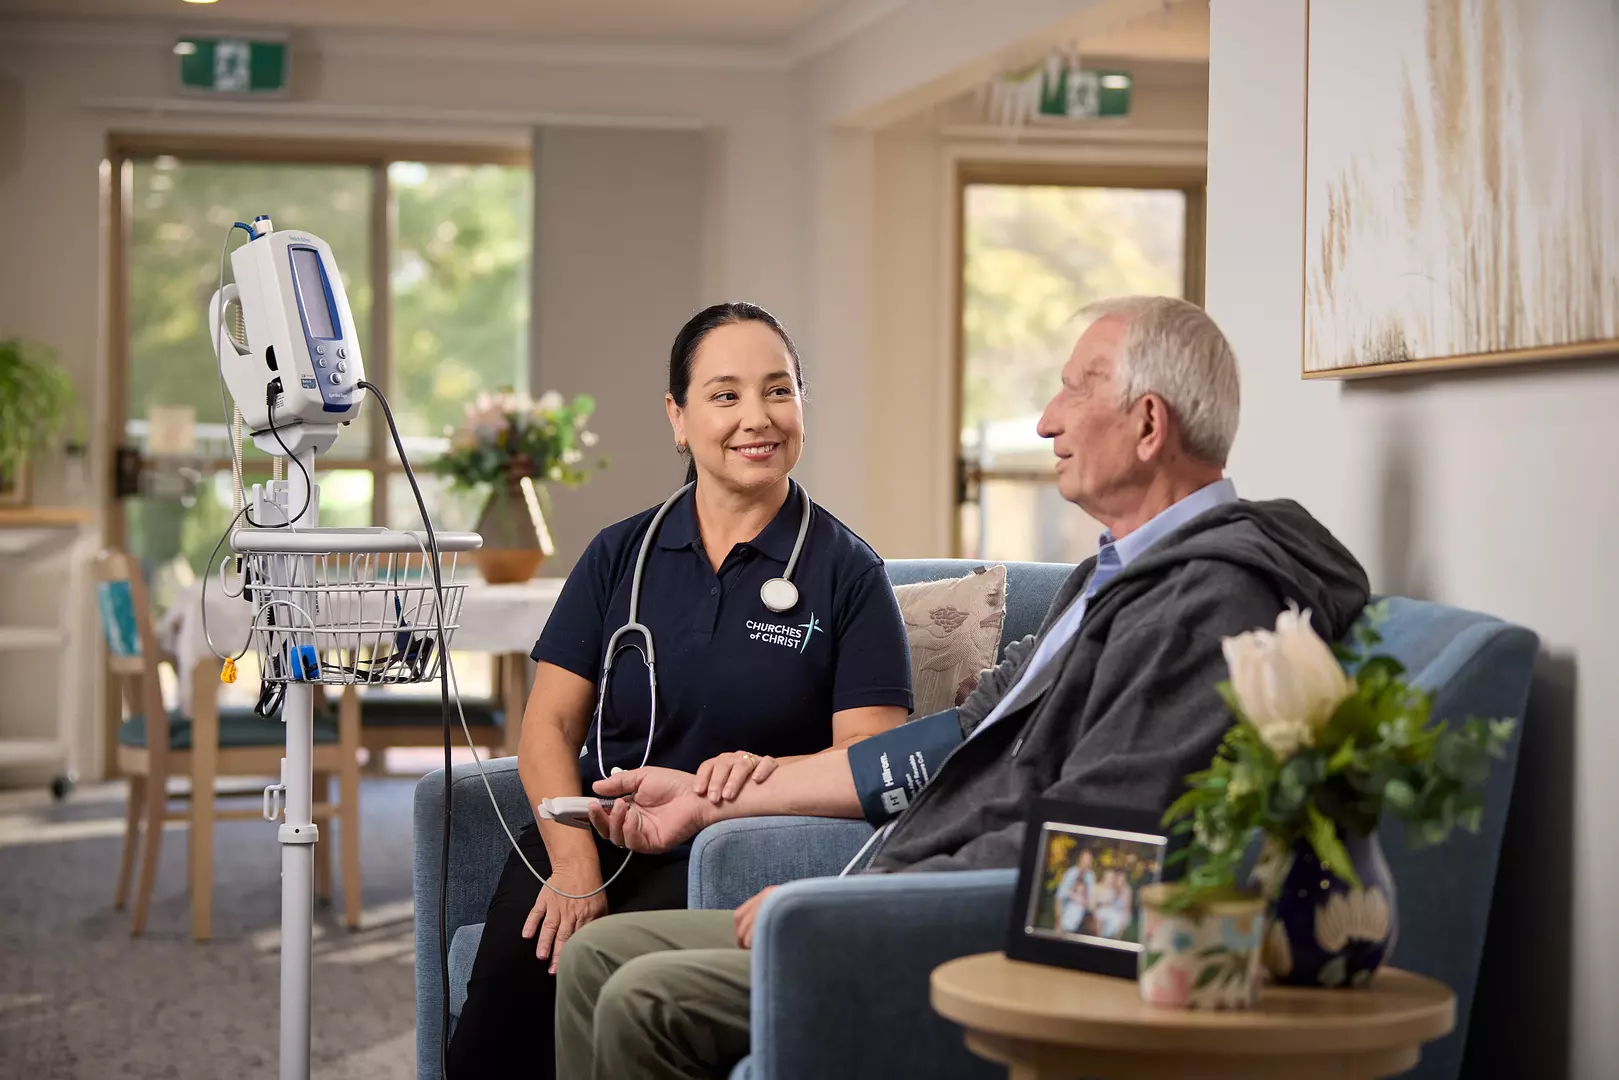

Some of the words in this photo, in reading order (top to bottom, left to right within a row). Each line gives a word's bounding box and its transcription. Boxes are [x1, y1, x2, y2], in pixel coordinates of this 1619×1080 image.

[746, 620, 802, 638] CHURCHES
[749, 632, 761, 640] of
[761, 633, 801, 649] CHRIST
